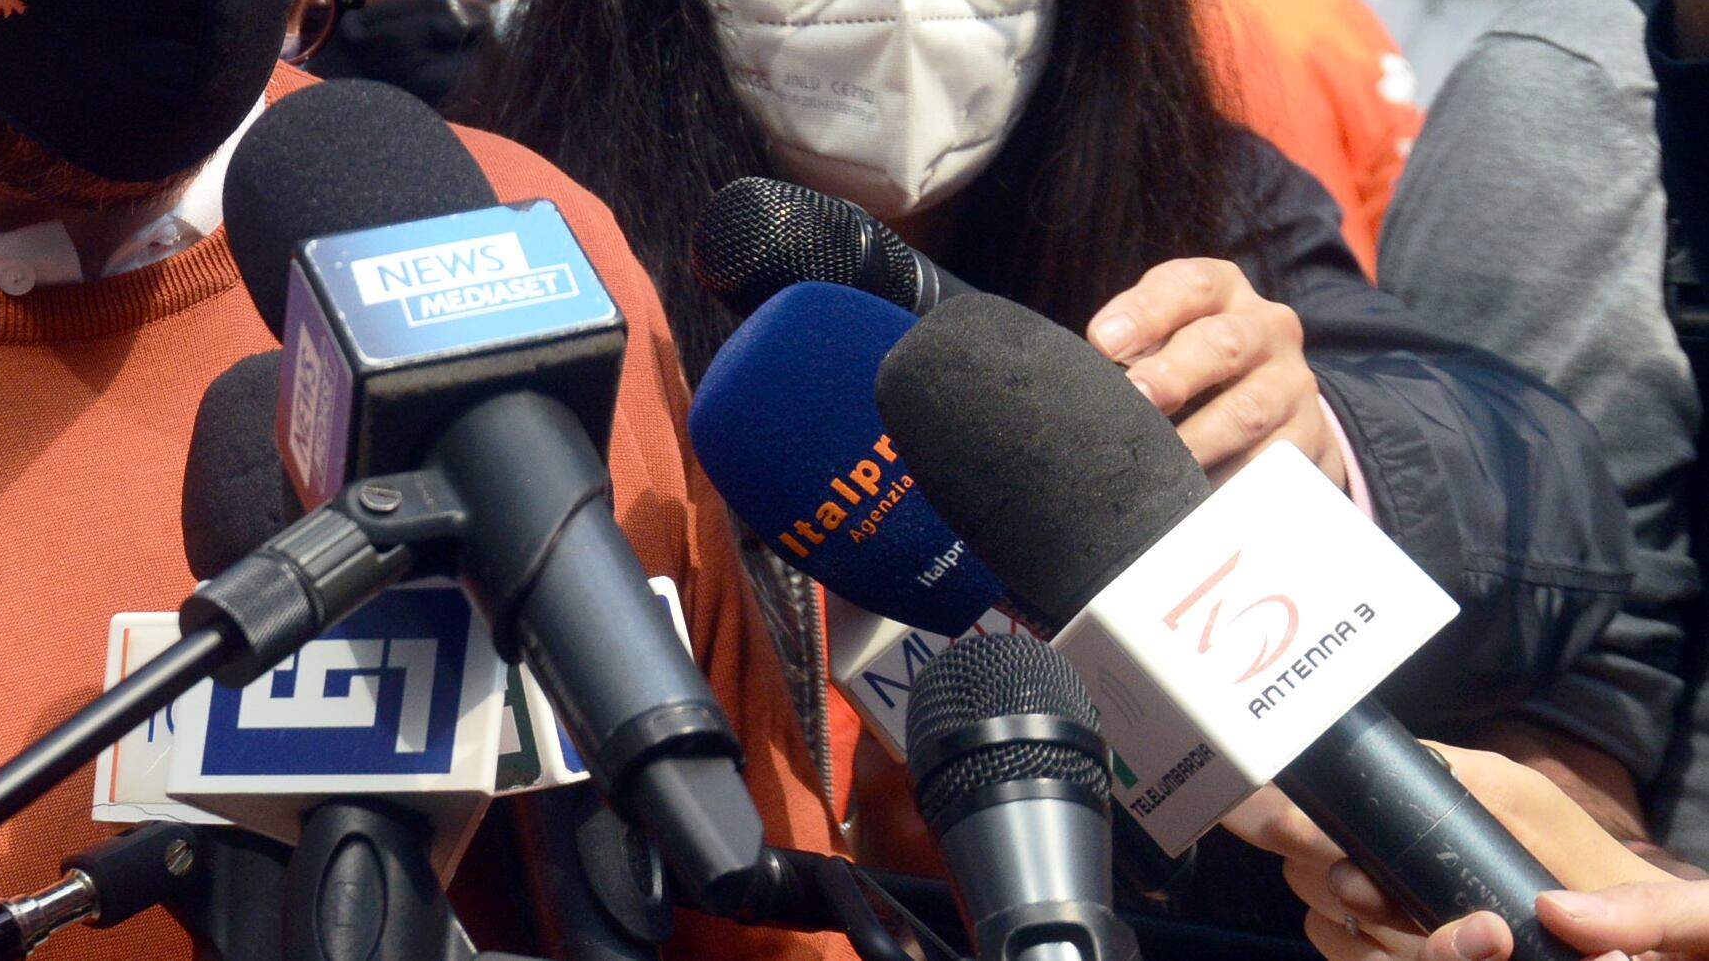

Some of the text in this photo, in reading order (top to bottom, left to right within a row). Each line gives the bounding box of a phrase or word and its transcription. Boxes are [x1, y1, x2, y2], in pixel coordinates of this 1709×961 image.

[377, 241, 505, 293] NEWS
[419, 270, 558, 318] MEDIASET
[779, 434, 898, 558] Italpr
[849, 473, 915, 544] Agenzia
[917, 539, 964, 587] italpr
[1248, 602, 1376, 719] ANTENNA 3
[1130, 742, 1216, 818] TELELOMBARDIA
